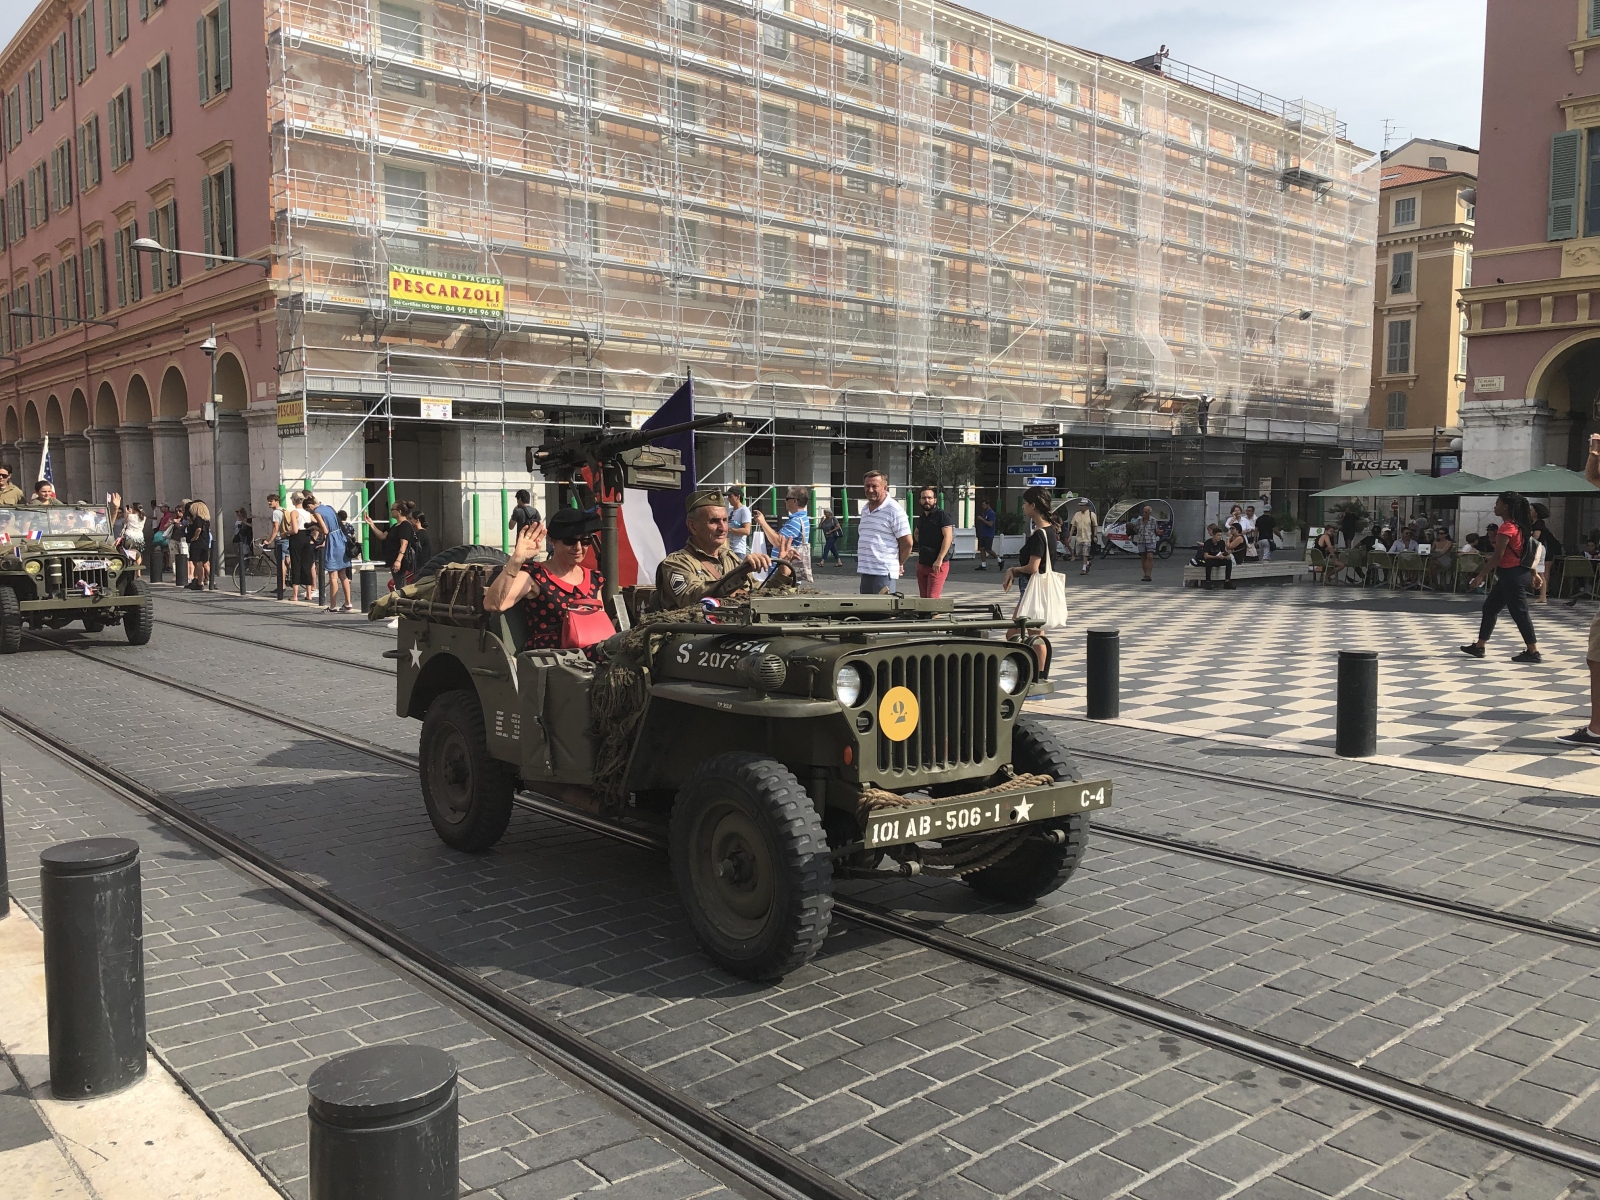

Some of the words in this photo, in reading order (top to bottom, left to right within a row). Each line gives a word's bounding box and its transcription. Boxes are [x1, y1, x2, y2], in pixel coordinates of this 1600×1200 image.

[308, 34, 344, 46] PESCARZOLI
[412, 59, 444, 71] PESCARZOLI
[311, 124, 346, 135] PESCARZOLI
[418, 143, 449, 154] PESCARZOLI
[314, 212, 348, 222] PESCARZOLI
[416, 227, 447, 236] PESCARZOLI
[393, 265, 448, 278] RAVALEMENT
[465, 275, 501, 285] FAÇADES
[392, 277, 500, 303] PESCARZOLI
[330, 296, 365, 304] PESCARZOLI
[1352, 460, 1400, 470] TIGER
[676, 643, 693, 663] S
[891, 700, 908, 725] 2
[1080, 786, 1105, 807] C-4
[872, 820, 899, 843] 101
